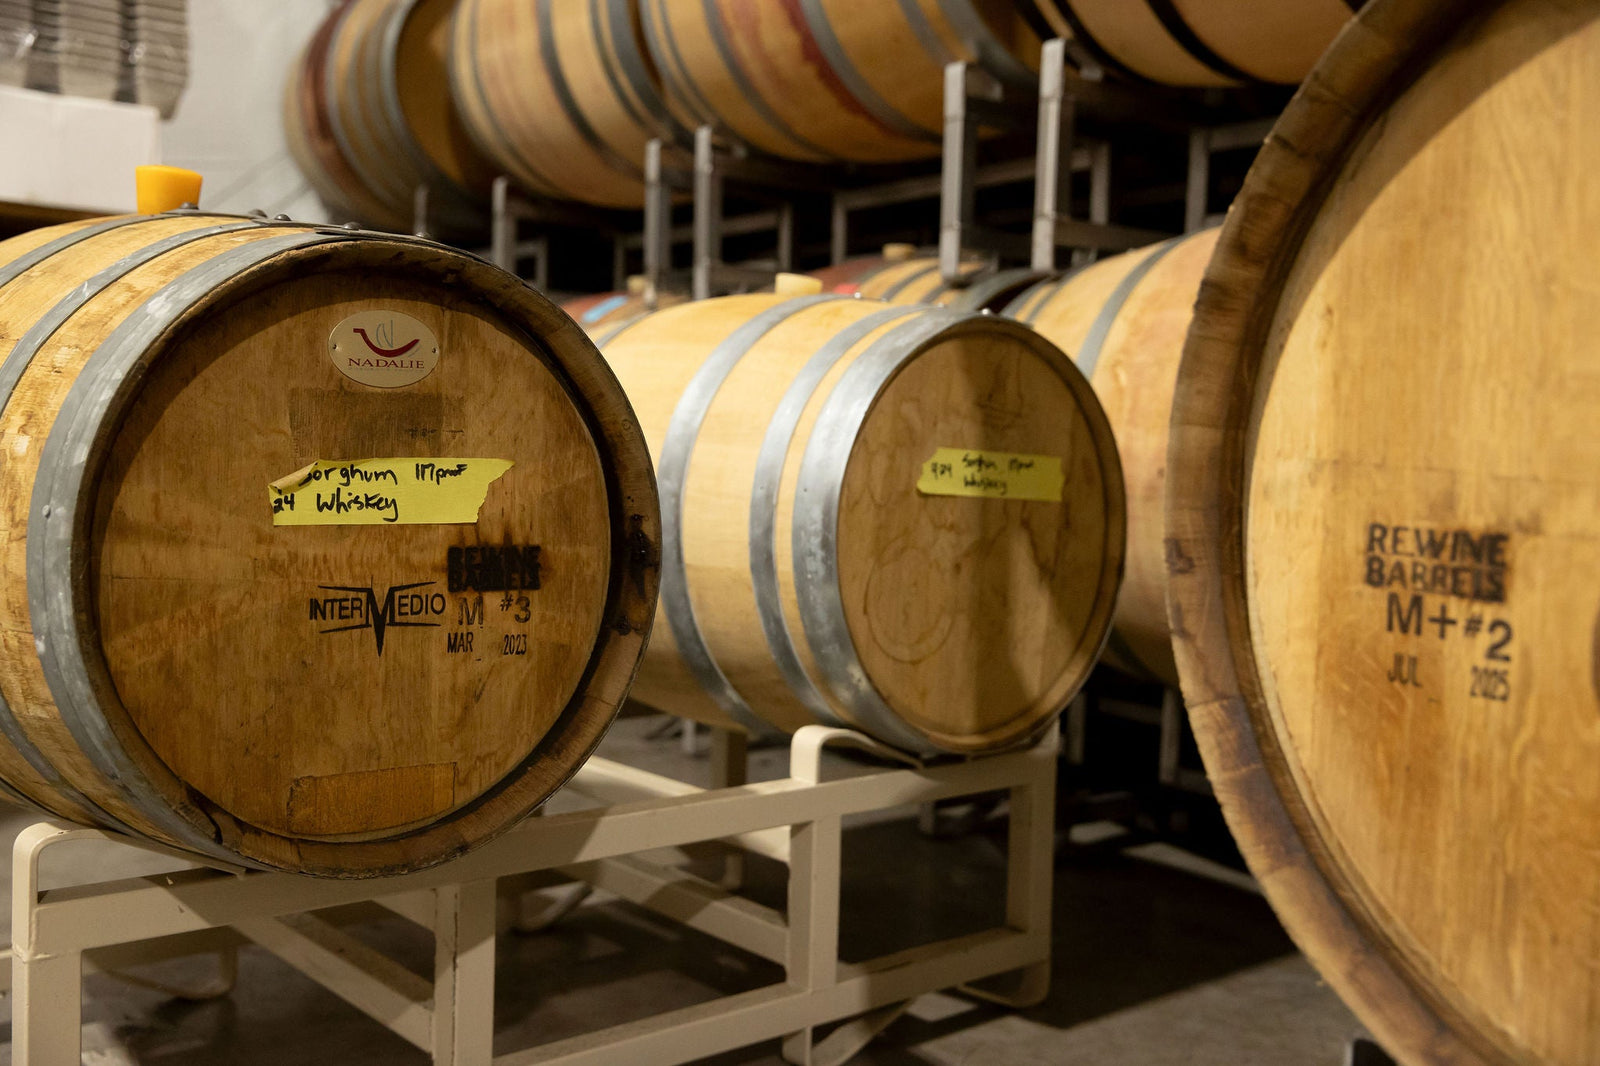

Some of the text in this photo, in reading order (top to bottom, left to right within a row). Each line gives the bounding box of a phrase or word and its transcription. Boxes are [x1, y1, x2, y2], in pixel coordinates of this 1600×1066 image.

[348, 357, 425, 369] NADALIE
[316, 487, 399, 523] Whiskey
[1367, 522, 1510, 569] REWINE
[1364, 554, 1508, 604] BARRELS
[309, 585, 447, 657] INTERMEDIO
[447, 632, 528, 655] MAR 2023
[1387, 652, 1423, 688] JUL
